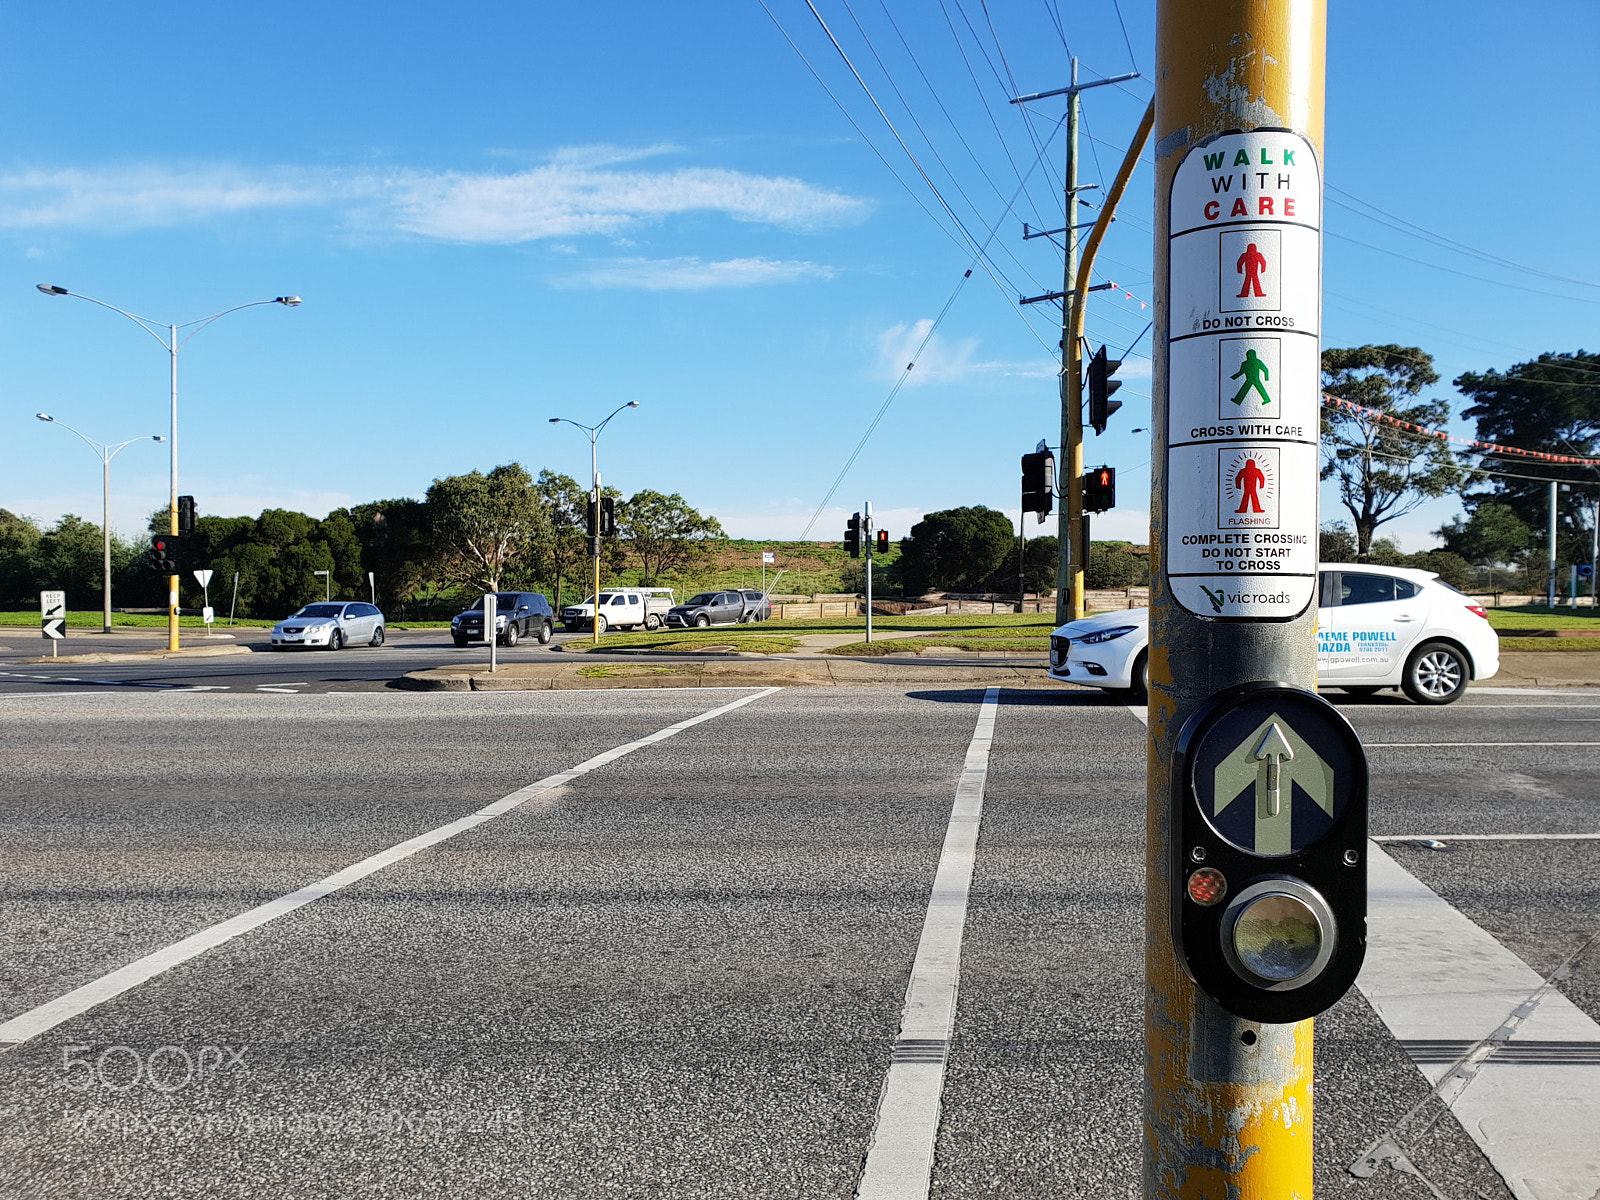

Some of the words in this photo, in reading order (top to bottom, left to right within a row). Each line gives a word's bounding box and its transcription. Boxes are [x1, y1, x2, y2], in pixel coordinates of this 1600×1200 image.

[1203, 147, 1296, 171] WALK
[1211, 173, 1290, 194] WITH
[1203, 196, 1296, 220] CARE
[1202, 317, 1220, 330] DO
[1224, 315, 1252, 328] NOT
[1255, 315, 1295, 327] CROSS
[1190, 426, 1234, 438] CROSS
[1238, 424, 1271, 436] WITH
[1276, 426, 1303, 437] CARE
[1228, 517, 1271, 526] FLASHING
[1181, 534, 1250, 545] COMPLETE
[1254, 533, 1307, 544] CROSSING
[1202, 548, 1220, 558] DO
[1224, 547, 1252, 558] NOT
[1255, 547, 1291, 558] START
[1216, 560, 1233, 571] TO
[1238, 560, 1281, 571] CROSS
[1227, 592, 1290, 605] vicroads
[1352, 632, 1397, 641] POWELL
